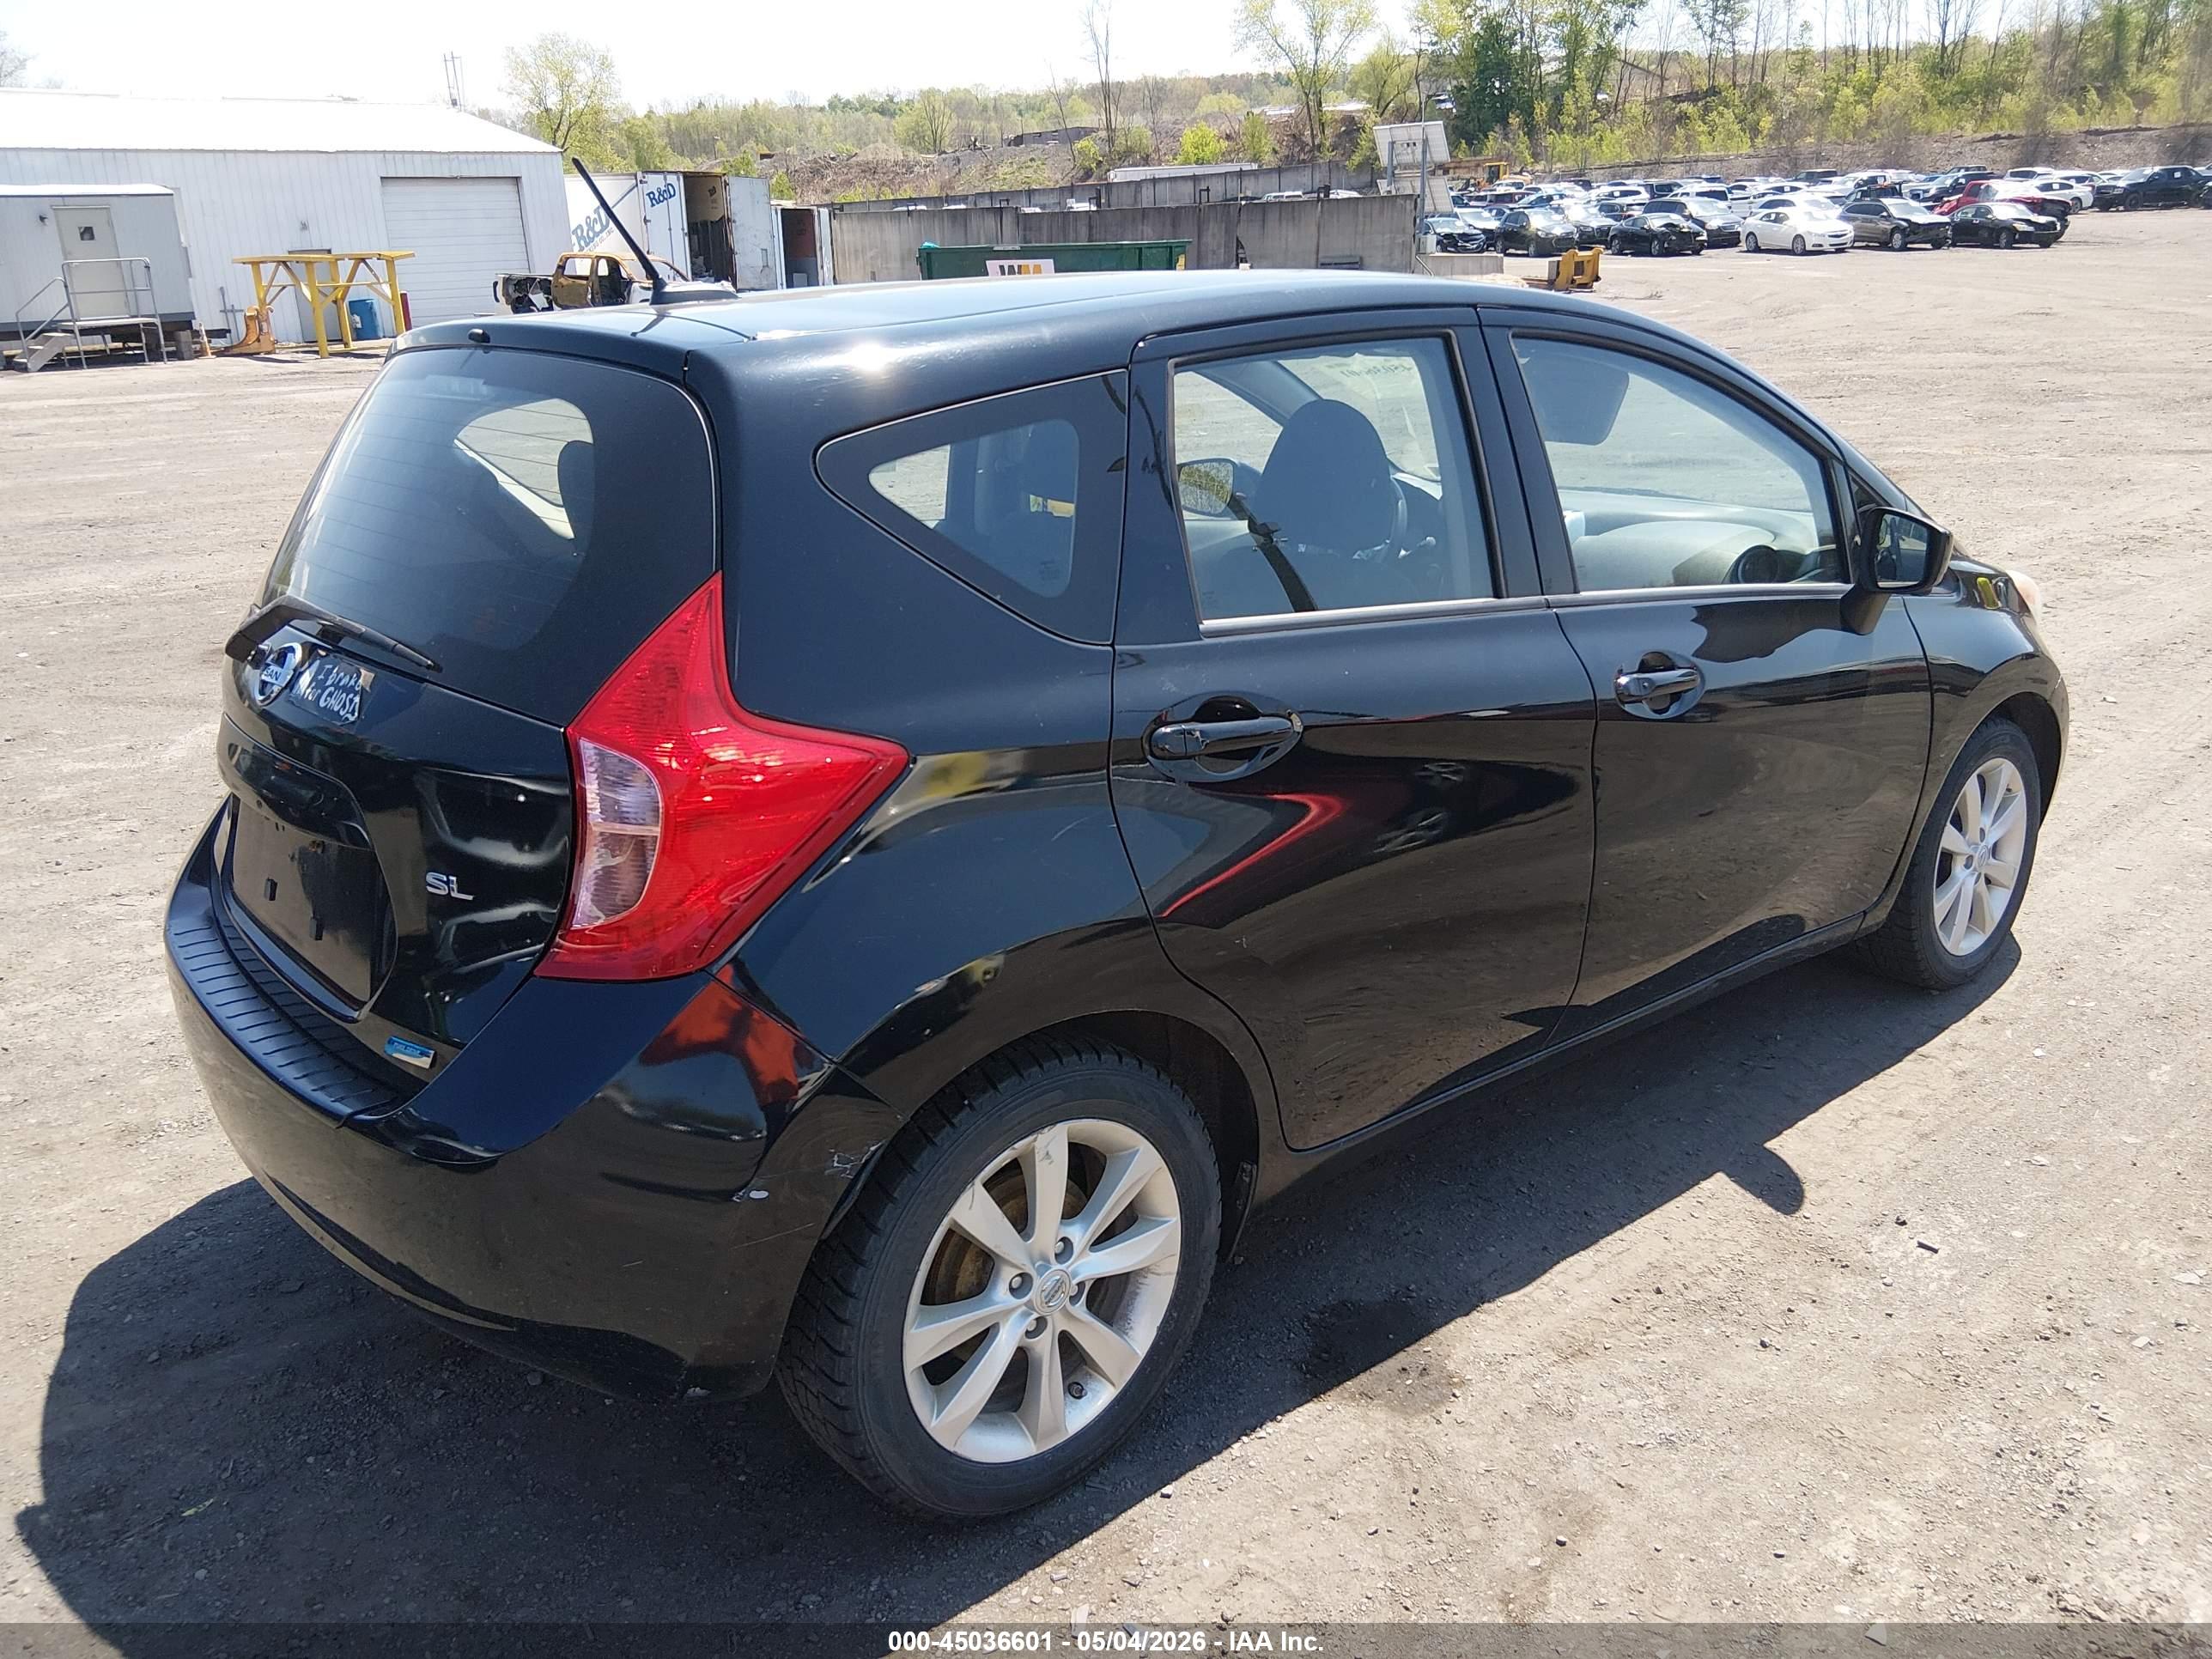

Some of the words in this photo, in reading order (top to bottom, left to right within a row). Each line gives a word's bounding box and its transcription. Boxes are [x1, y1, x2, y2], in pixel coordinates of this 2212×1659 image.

[646, 183, 676, 208] R&D
[318, 665, 333, 680] I
[304, 681, 322, 702] for
[425, 872, 474, 901] SL
